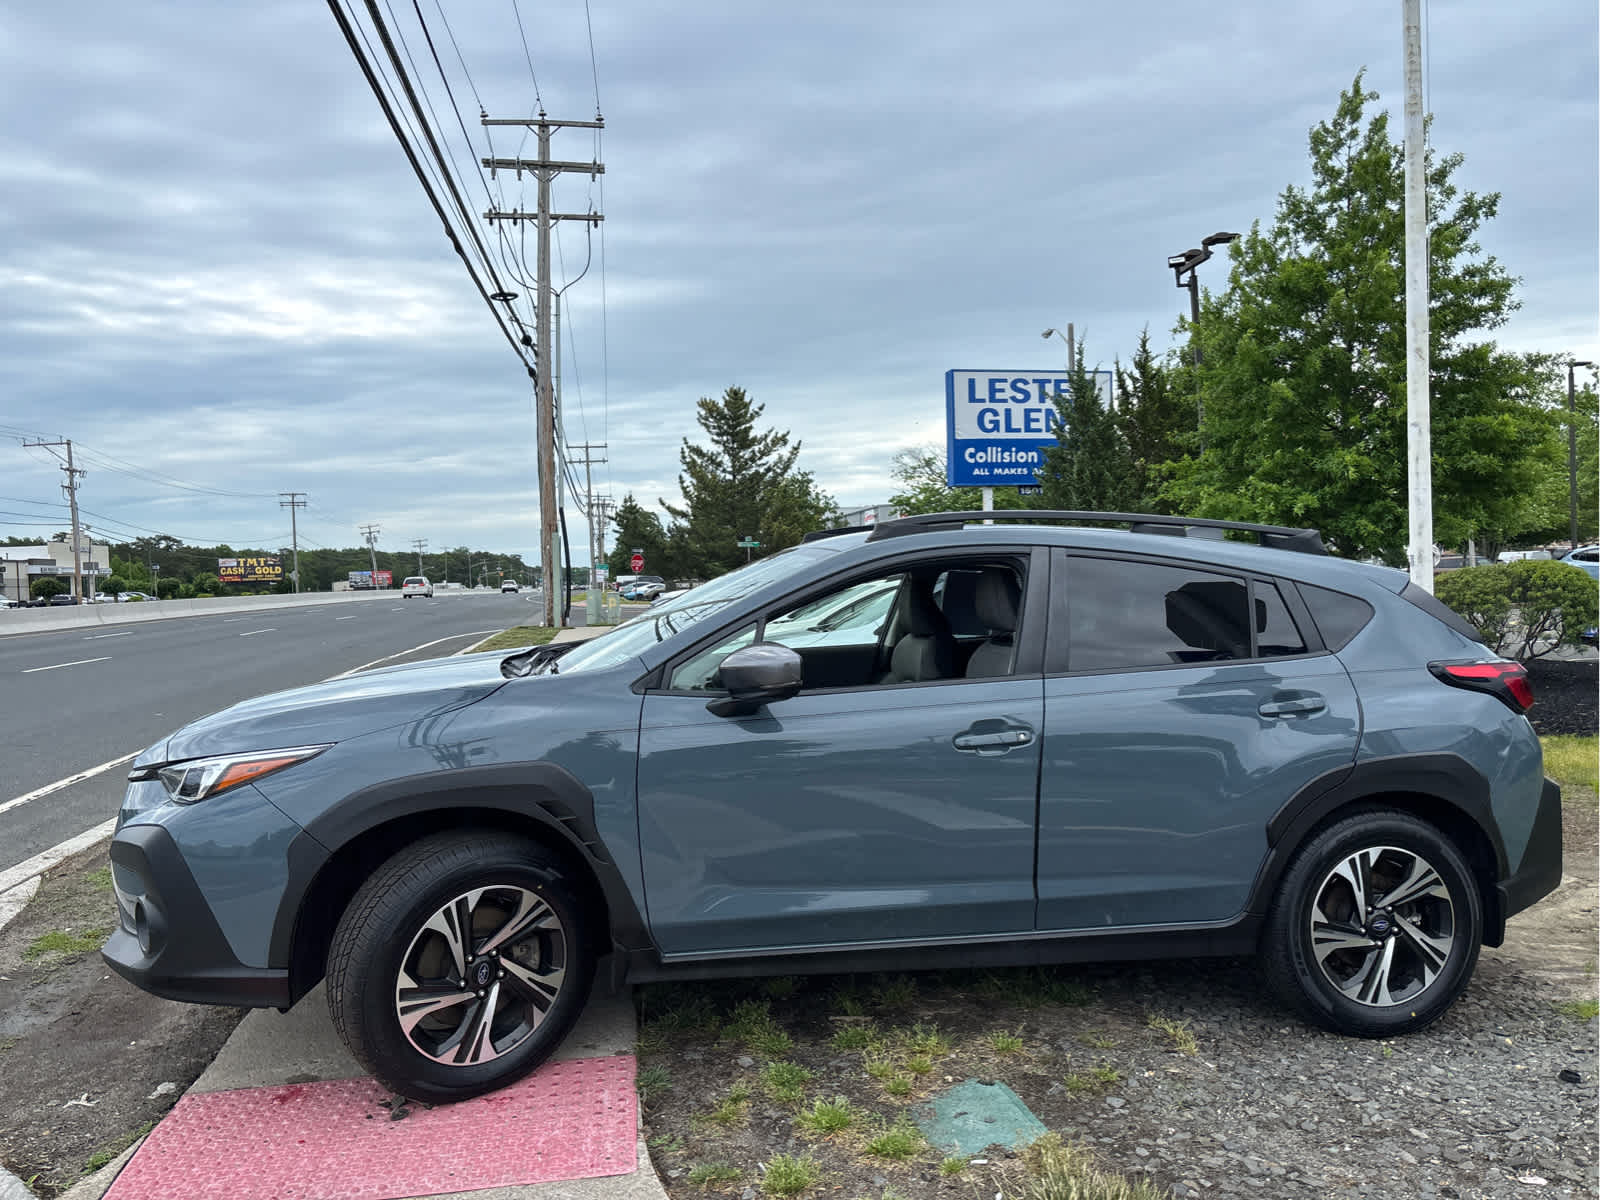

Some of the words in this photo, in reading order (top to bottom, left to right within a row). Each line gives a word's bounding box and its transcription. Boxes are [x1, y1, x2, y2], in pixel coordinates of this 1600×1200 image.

[968, 378, 1091, 404] LESTE
[964, 447, 1038, 463] Collision
[973, 467, 990, 476] ALL
[993, 467, 1028, 476] MAKES
[238, 558, 266, 567] TMT
[220, 567, 244, 575] CASH
[255, 566, 282, 574] GOLD
